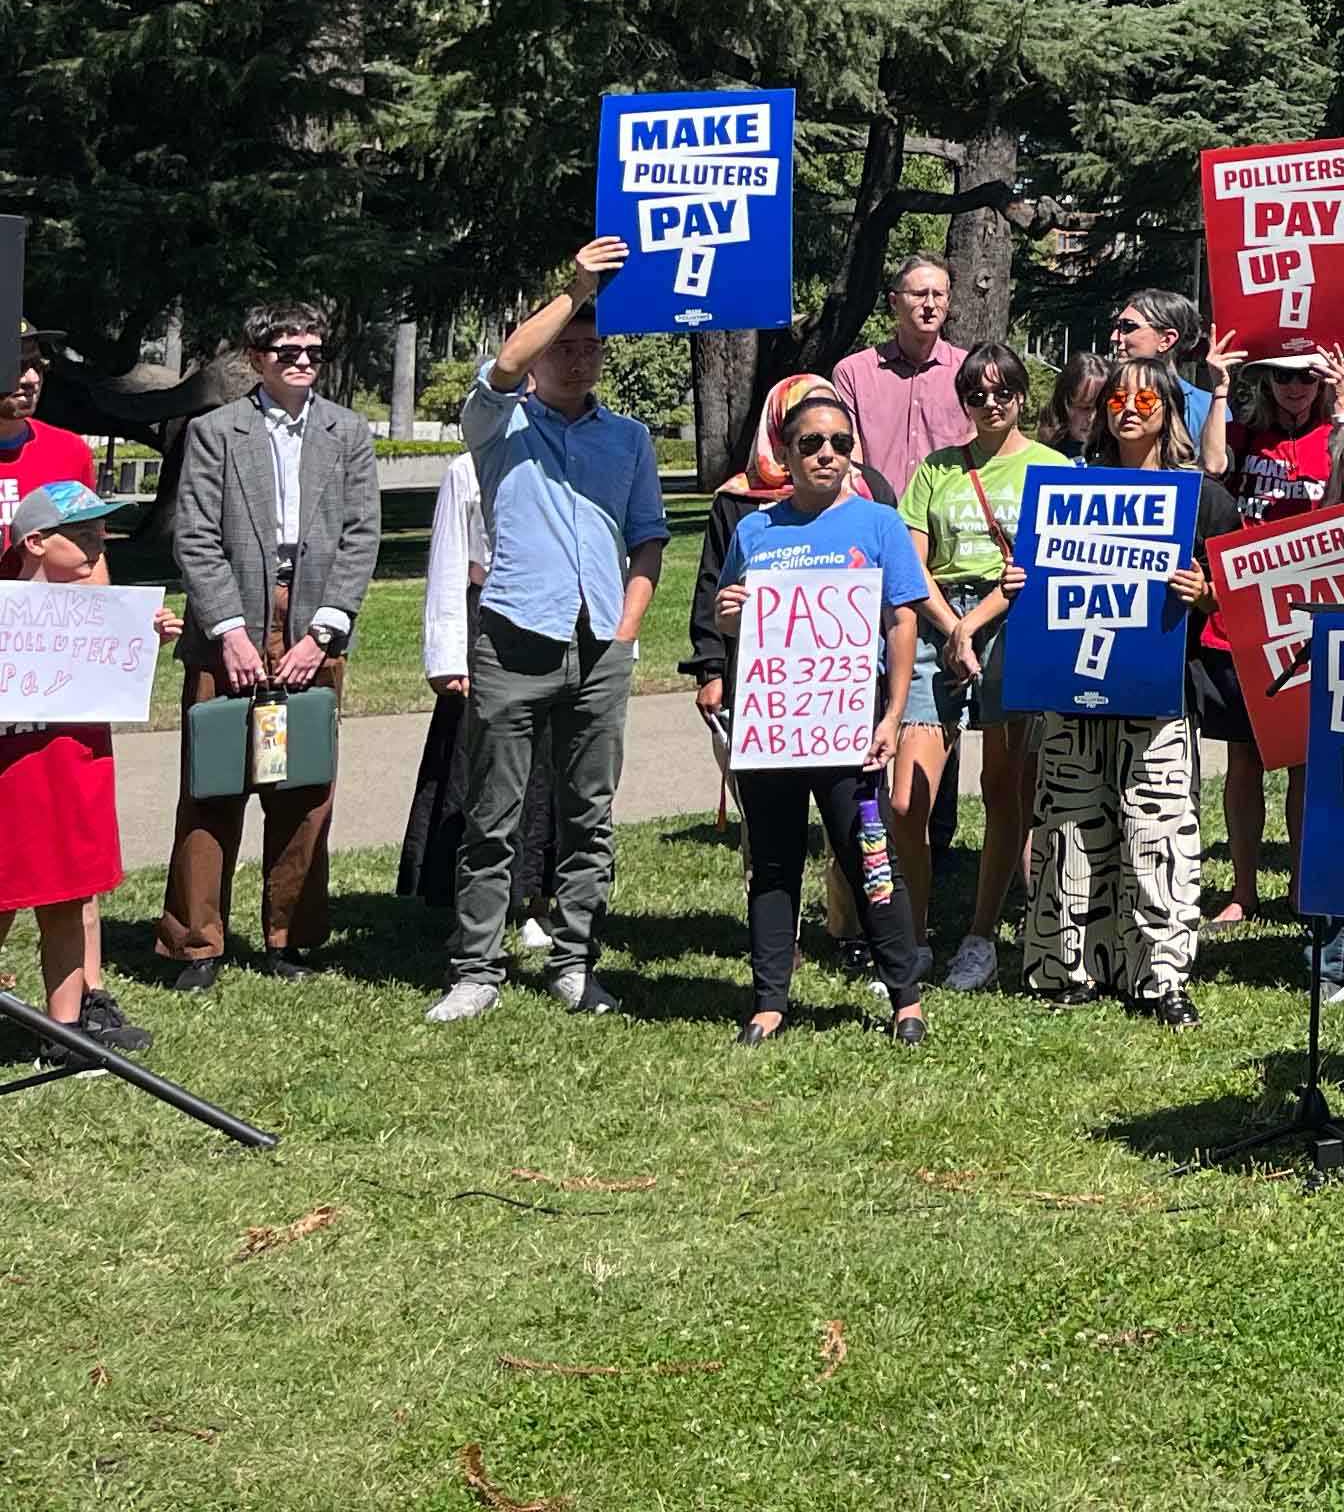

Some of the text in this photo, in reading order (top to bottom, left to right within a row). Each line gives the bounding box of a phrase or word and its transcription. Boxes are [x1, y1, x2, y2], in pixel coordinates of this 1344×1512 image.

[631, 113, 759, 151] MAKE
[634, 163, 769, 187] POLLUTERS
[650, 199, 737, 241] PAY
[1254, 200, 1342, 238] PAY
[686, 253, 705, 288] !
[1249, 250, 1302, 285] UP
[1289, 292, 1304, 322] !
[1047, 493, 1167, 526] MAKE
[750, 544, 811, 565] nextgen
[770, 552, 845, 569] california
[1046, 538, 1170, 573] POLLUTERS
[0, 589, 105, 626] MAKE
[756, 585, 872, 650] PASS
[1057, 583, 1139, 620] PAY
[1086, 635, 1106, 670] !
